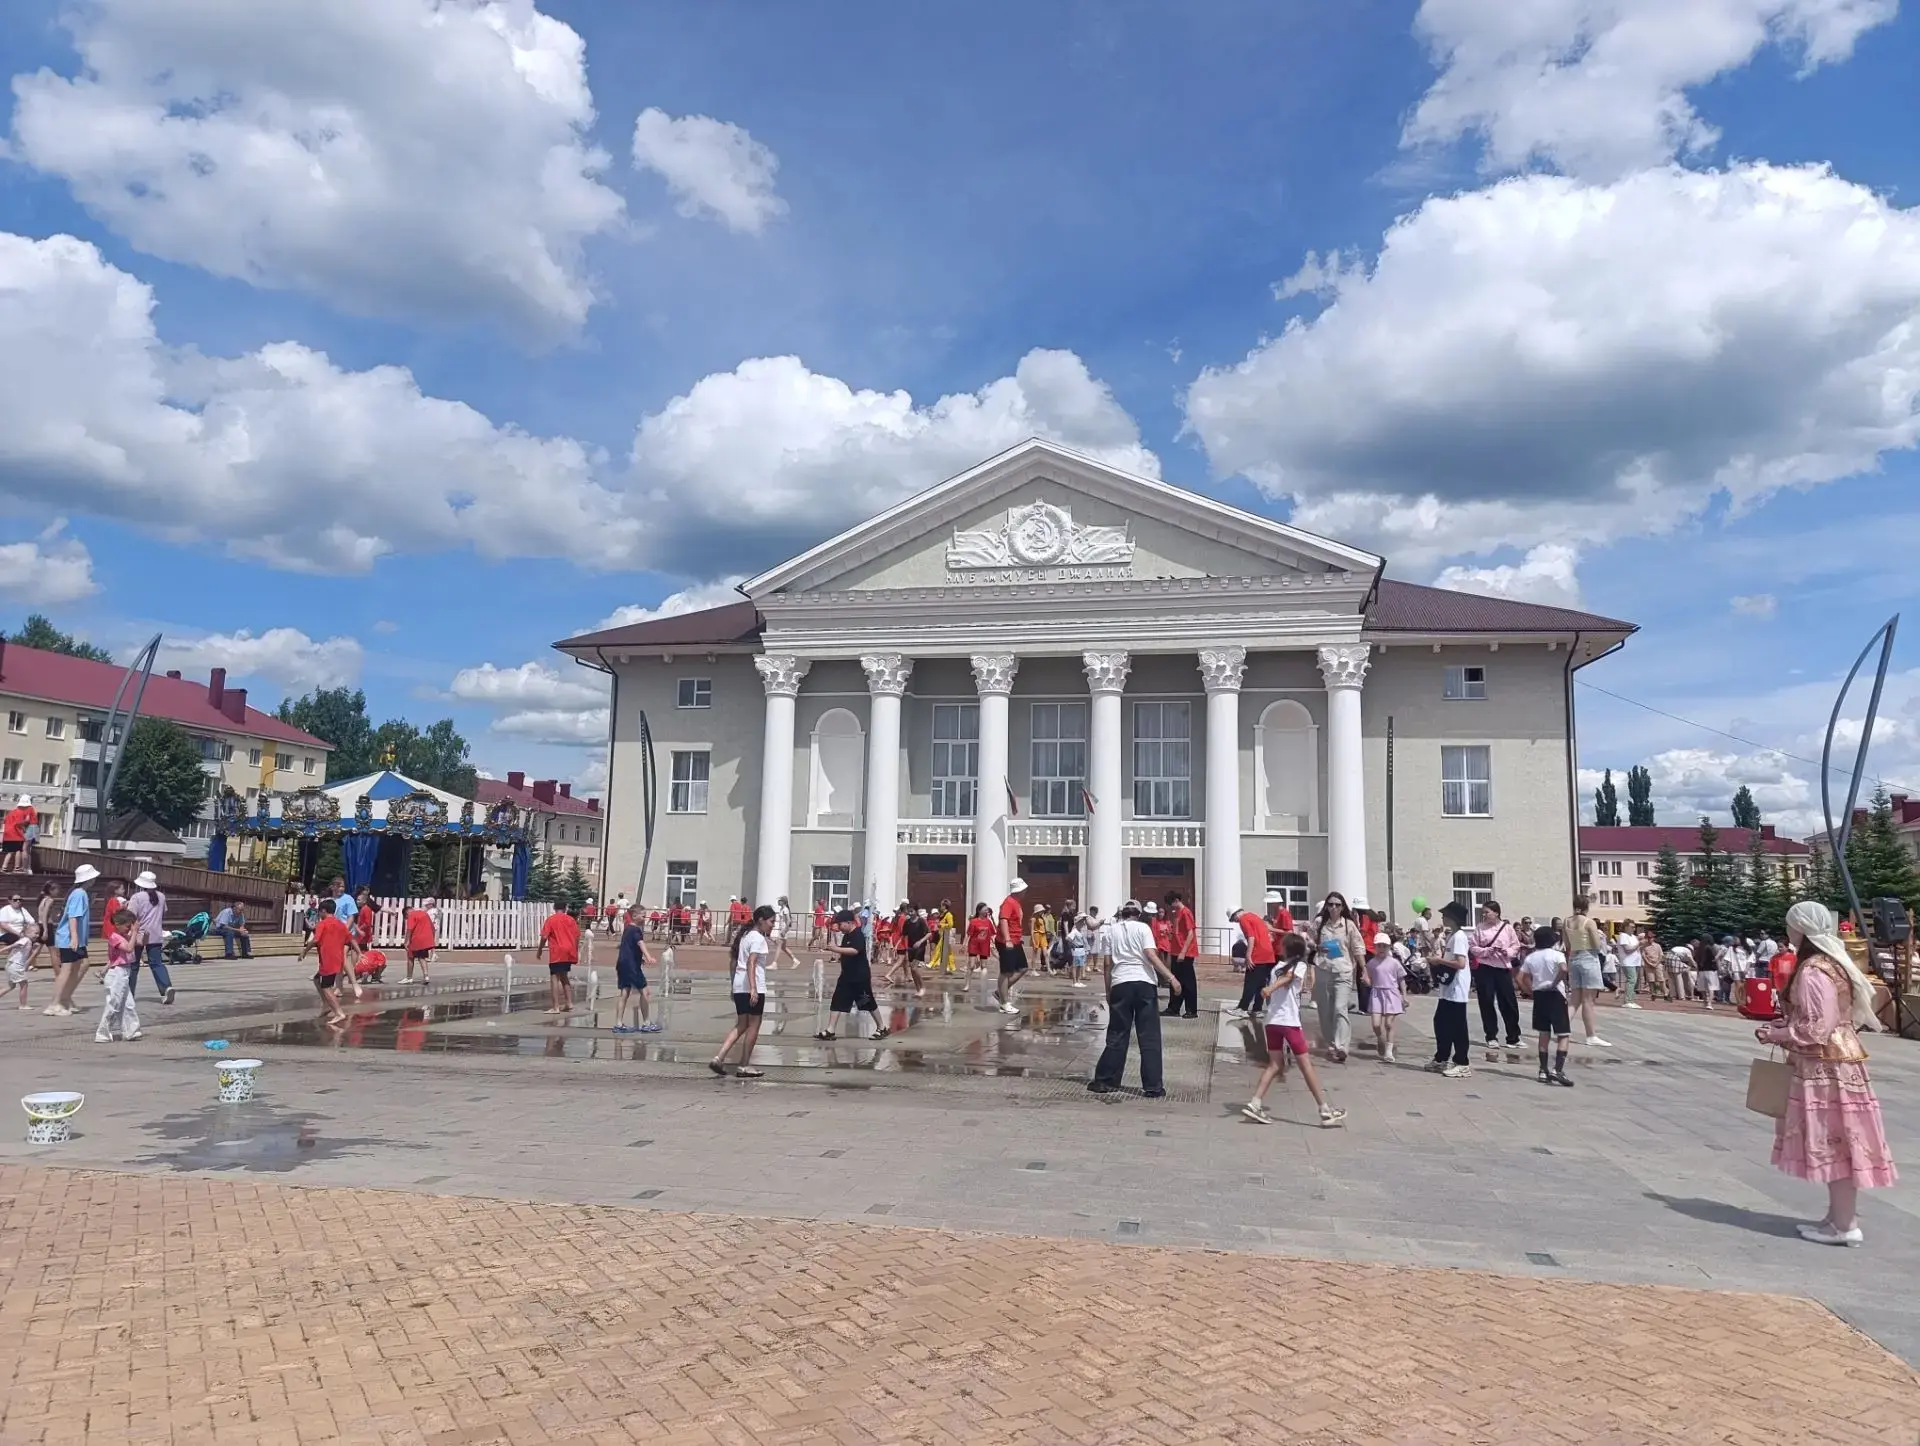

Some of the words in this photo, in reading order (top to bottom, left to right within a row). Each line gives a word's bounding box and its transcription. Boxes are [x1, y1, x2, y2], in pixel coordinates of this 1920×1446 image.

[945, 570, 976, 584] КЛУБ
[1000, 569, 1046, 582] МУСЫ
[1058, 566, 1133, 580] ДЖАЛИЛЯ
